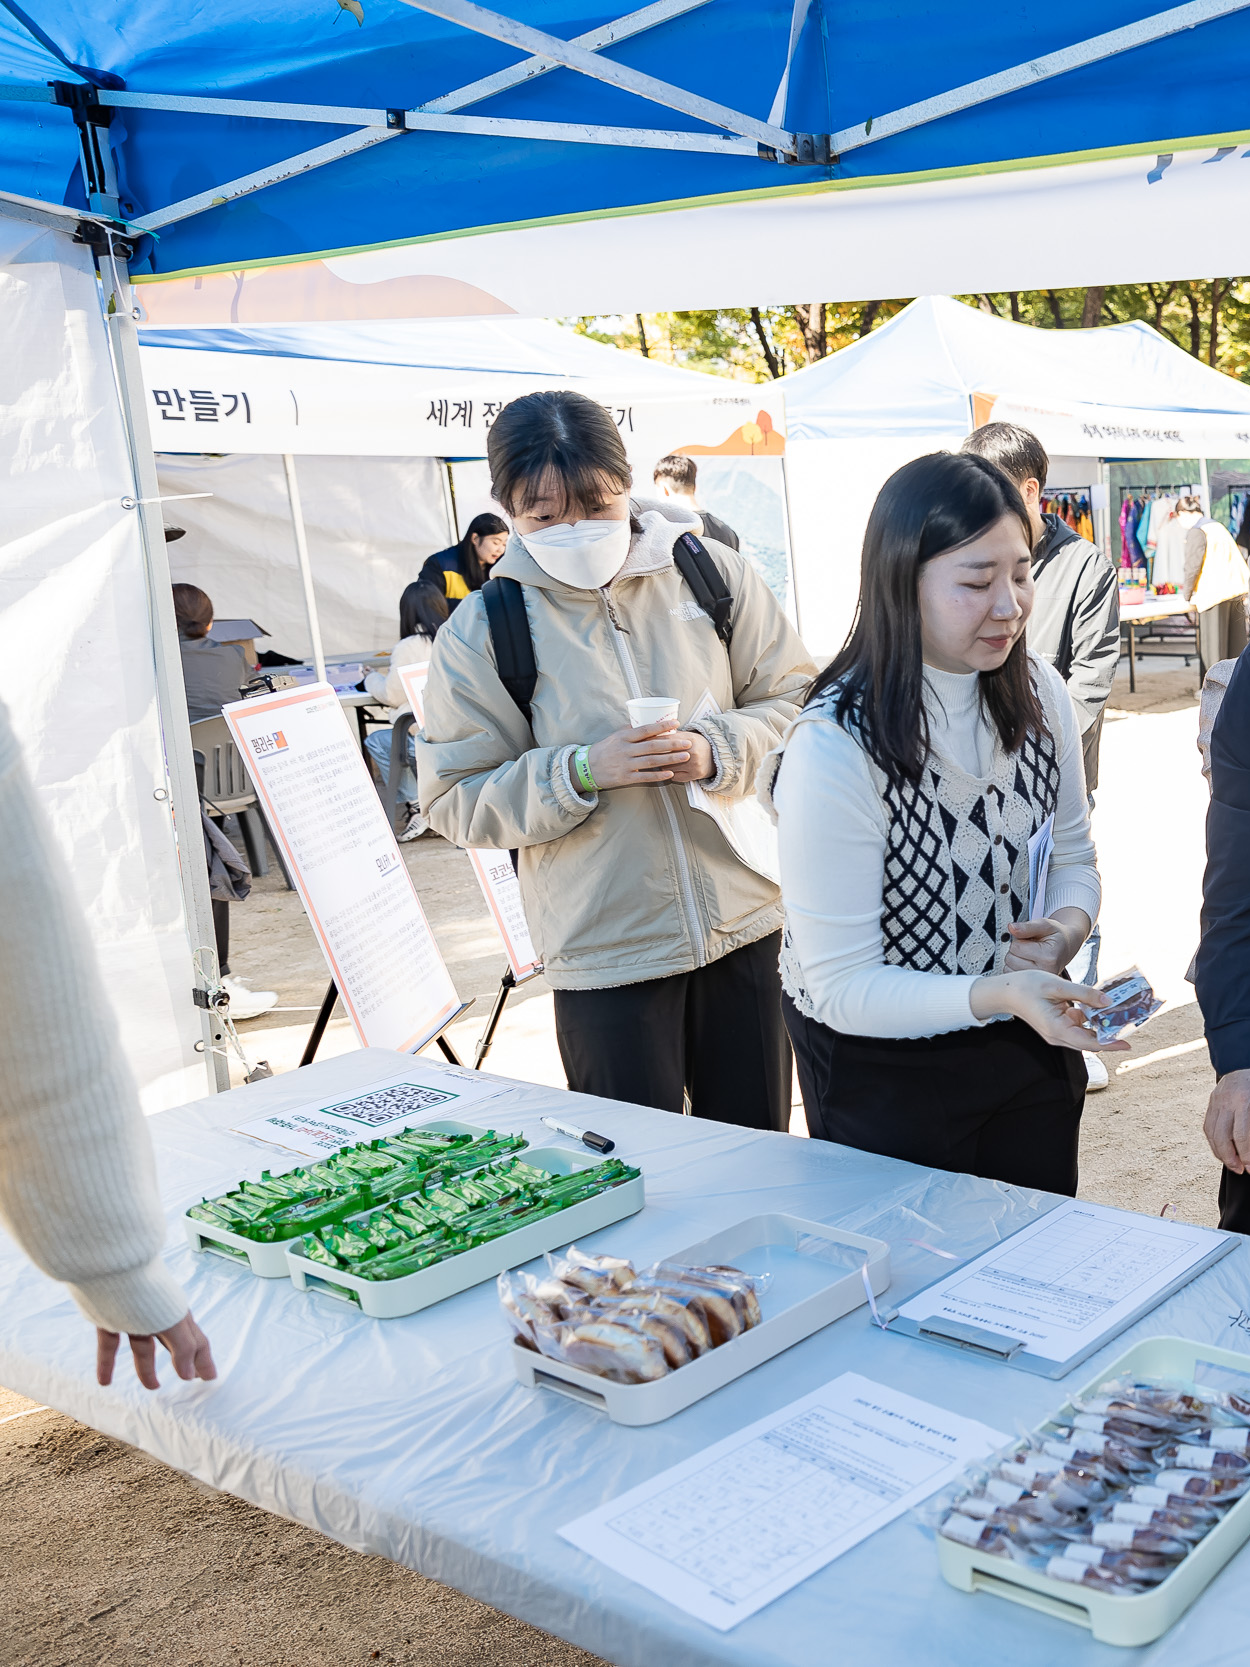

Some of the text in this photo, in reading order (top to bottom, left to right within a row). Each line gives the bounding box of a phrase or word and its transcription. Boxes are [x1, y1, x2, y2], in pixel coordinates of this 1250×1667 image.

[152, 388, 251, 424] 만들기
[426, 399, 474, 428] 세계
[250, 737, 275, 754] 펑리수
